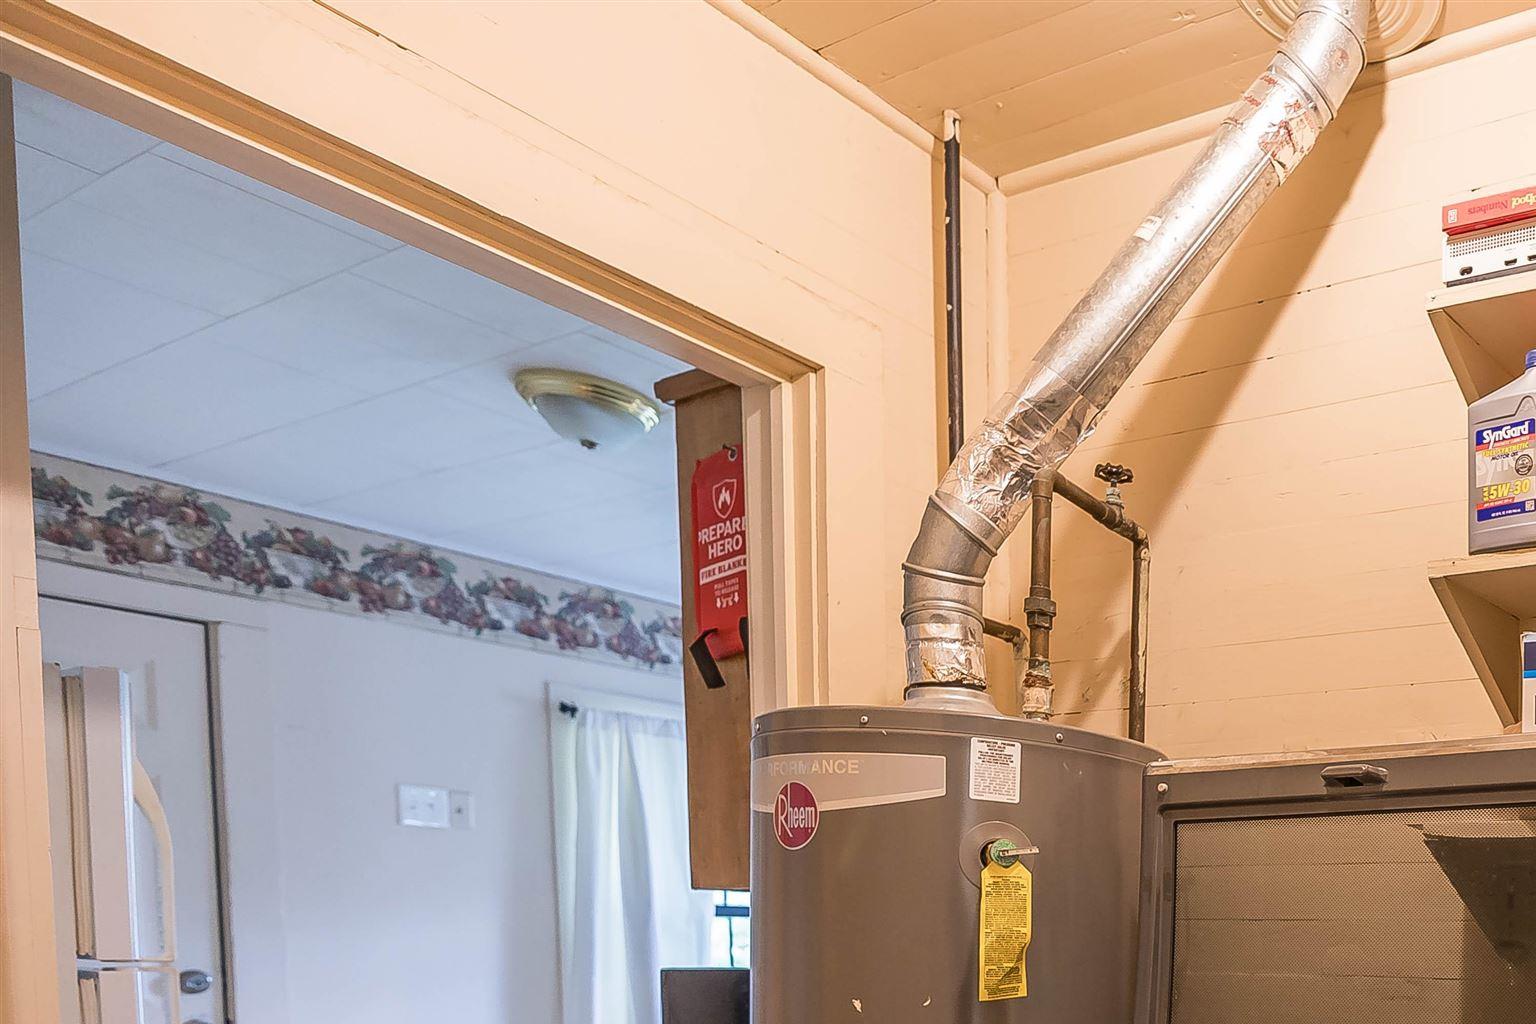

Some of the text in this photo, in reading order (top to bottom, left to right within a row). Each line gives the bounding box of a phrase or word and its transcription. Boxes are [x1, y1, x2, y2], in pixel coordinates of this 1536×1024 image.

[1482, 421, 1531, 450] SynGard
[708, 534, 743, 560] HERO
[778, 782, 815, 838] Rheem
